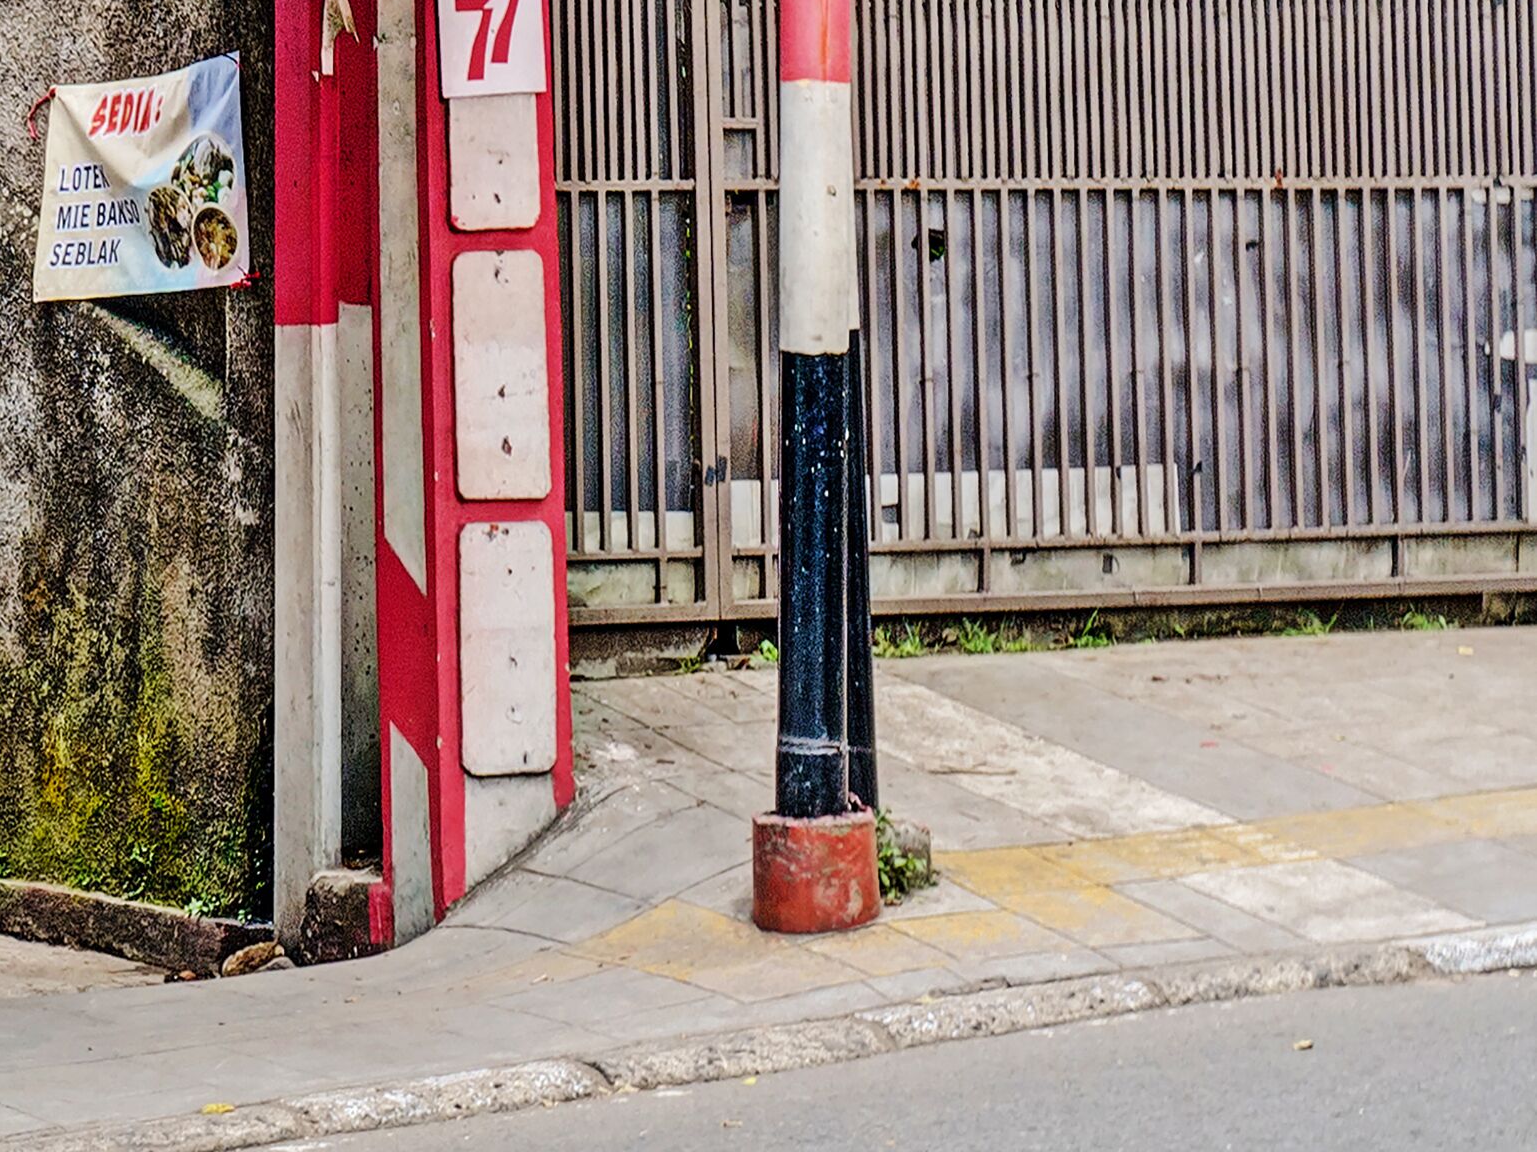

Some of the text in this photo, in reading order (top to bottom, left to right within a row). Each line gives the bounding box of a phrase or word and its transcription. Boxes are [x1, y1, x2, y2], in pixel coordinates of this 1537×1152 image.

[88, 88, 164, 137] SEDIA:
[56, 200, 141, 231] MIE BAKSO
[49, 239, 122, 266] SEBLAK
